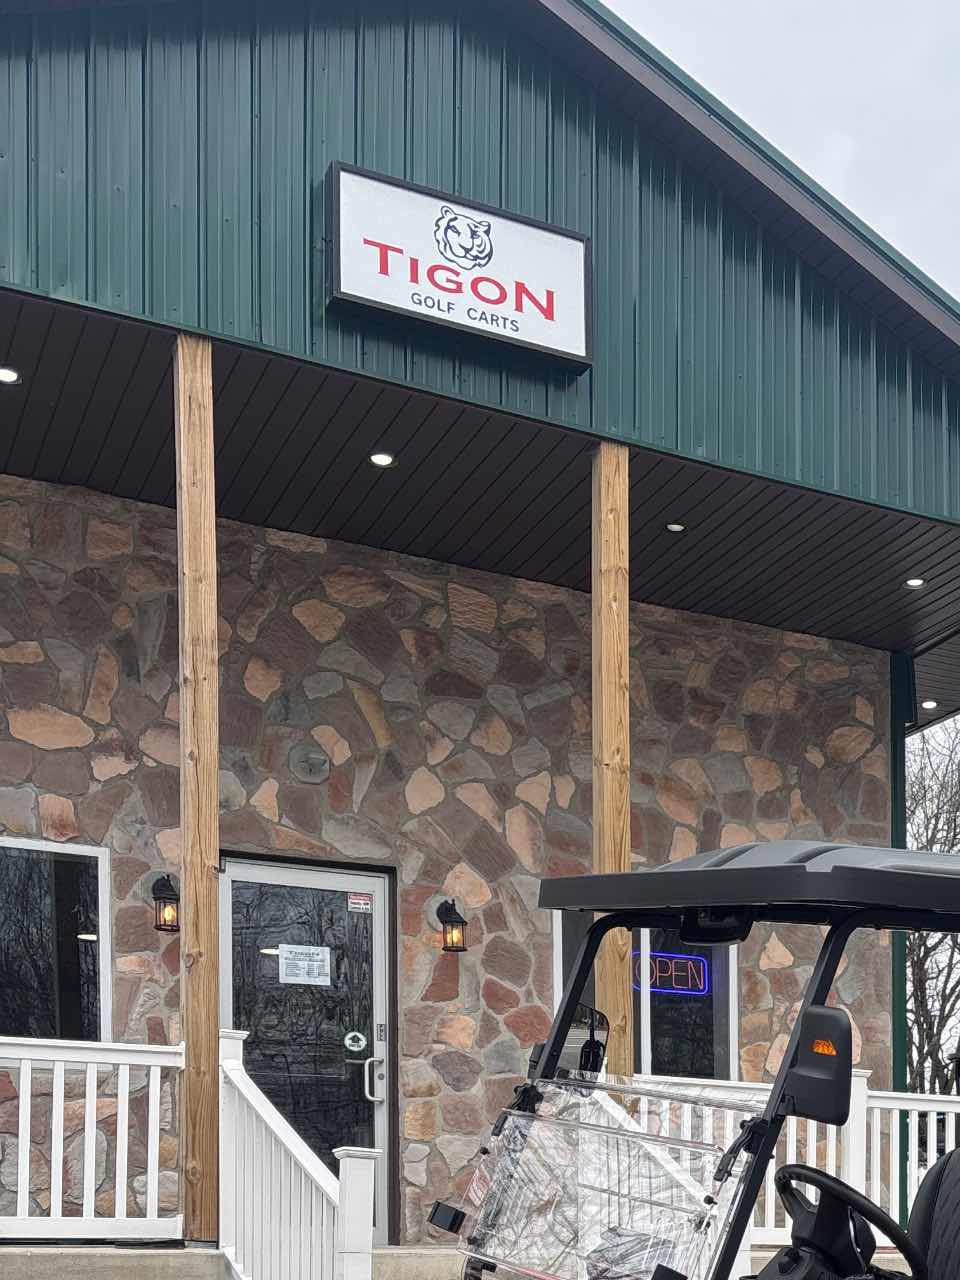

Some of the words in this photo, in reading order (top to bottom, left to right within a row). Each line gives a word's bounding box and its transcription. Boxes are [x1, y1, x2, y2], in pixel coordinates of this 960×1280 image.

[363, 238, 555, 321] TIGON
[411, 292, 455, 314] GOLF
[467, 307, 520, 332] CARTS
[635, 957, 704, 990] OPEN
